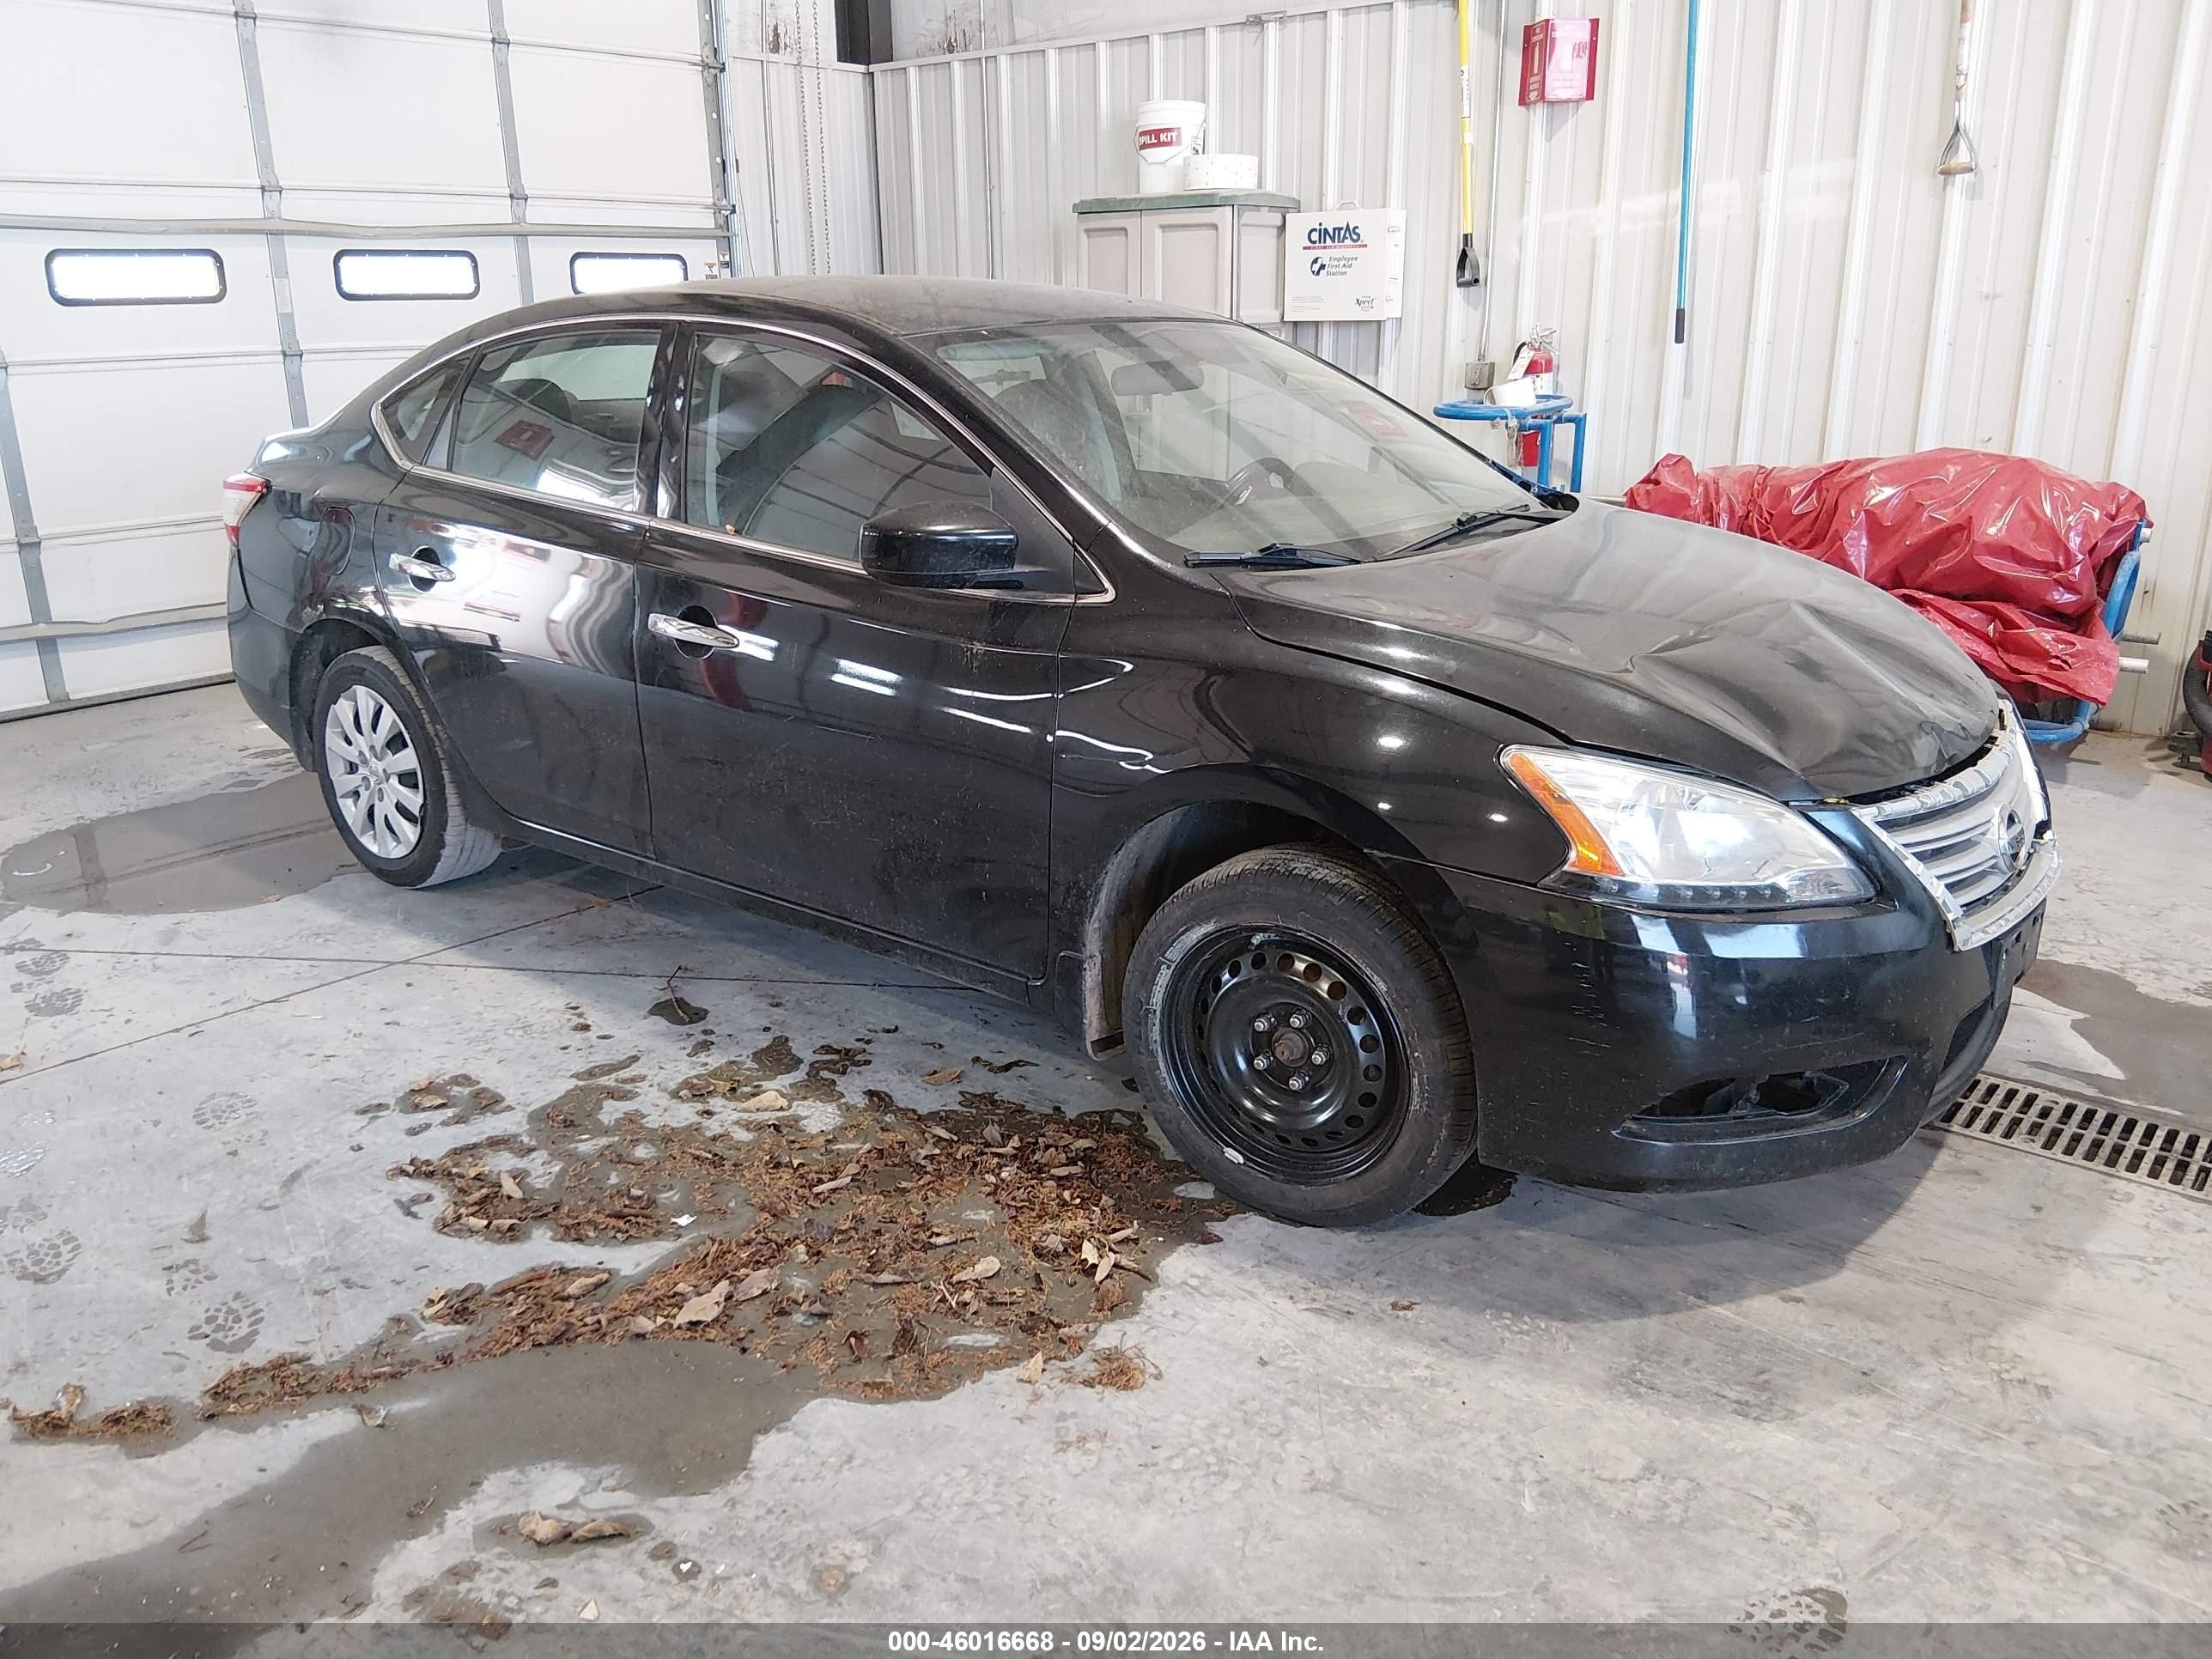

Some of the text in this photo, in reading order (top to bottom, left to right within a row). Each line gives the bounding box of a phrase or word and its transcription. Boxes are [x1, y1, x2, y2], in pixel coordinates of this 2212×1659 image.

[1139, 131, 1177, 146] SPILL KIT
[1307, 221, 1361, 245] CINTAS
[1329, 255, 1358, 264] Employee
